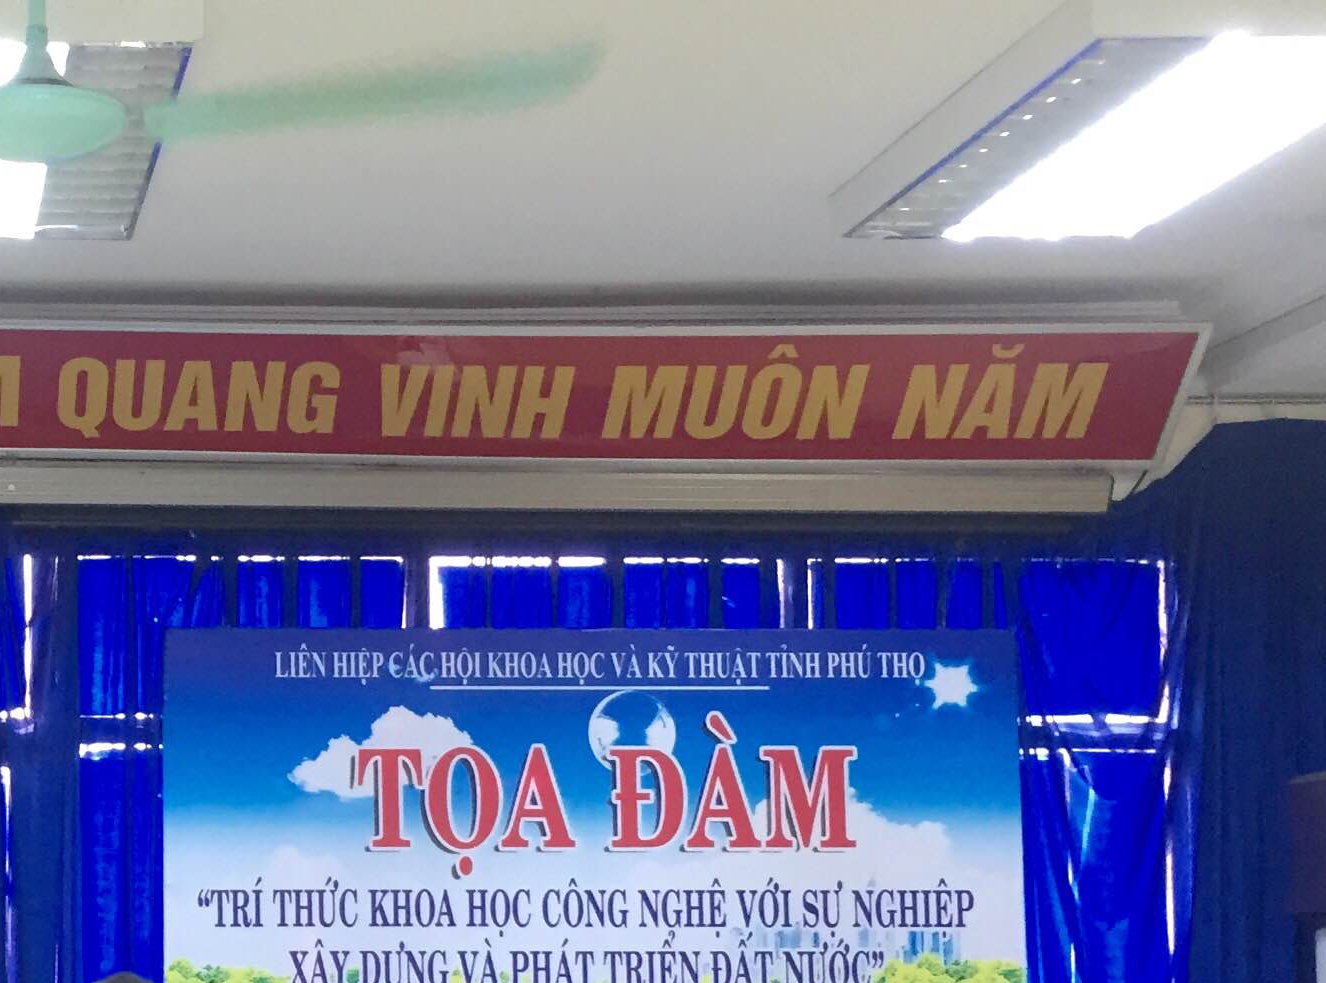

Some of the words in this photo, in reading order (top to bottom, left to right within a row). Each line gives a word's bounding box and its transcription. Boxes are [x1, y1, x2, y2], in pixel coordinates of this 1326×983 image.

[58, 357, 341, 438] QUANG
[380, 363, 576, 438] VINH
[602, 344, 870, 440] MUÔN
[892, 343, 1109, 440] NĂM
[275, 643, 326, 678] LIÊN
[332, 648, 384, 685] HIỆP
[388, 643, 435, 679] CÁC
[440, 648, 481, 685] HỘI
[487, 651, 552, 678] KHOA
[557, 650, 605, 686] HỌC
[611, 644, 643, 678] VÀ
[647, 644, 680, 678] KỸ
[685, 648, 761, 686] THUẬT
[766, 643, 822, 678] TỈNH
[826, 643, 871, 678] PHÚ
[877, 650, 925, 686] THỌ
[354, 744, 576, 877] TỌA
[605, 711, 858, 852] ĐÀM
[273, 876, 359, 929] THỨC
[368, 889, 457, 928] KHOA
[465, 889, 532, 938] HỌC
[541, 878, 629, 929] CÔNG
[637, 878, 727, 938] NGHỆ
[735, 877, 794, 929] VỚI
[802, 880, 844, 938] SỰ
[852, 878, 975, 939] NGHIỆP
